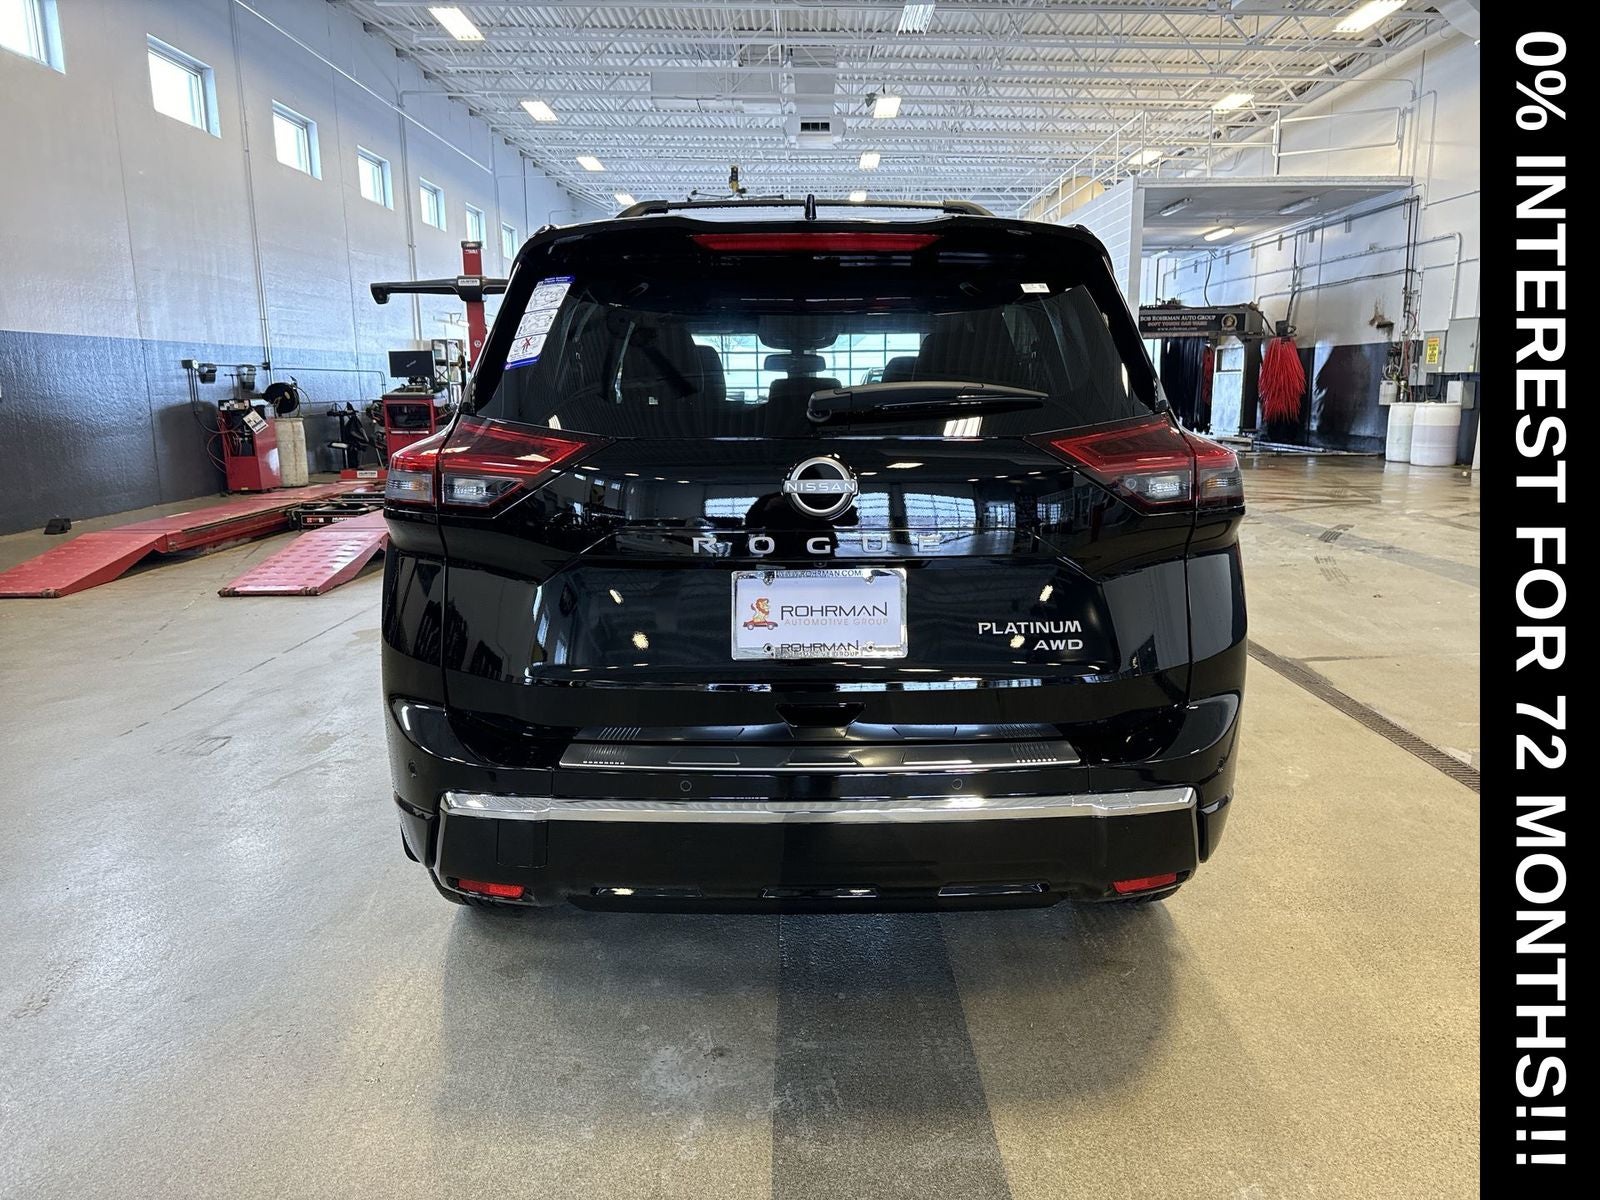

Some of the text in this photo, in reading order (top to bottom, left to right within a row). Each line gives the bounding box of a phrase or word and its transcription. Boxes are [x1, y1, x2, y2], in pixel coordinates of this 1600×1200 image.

[786, 482, 855, 492] NISSAN
[692, 537, 941, 555] ROGUE
[780, 602, 888, 620] ROHRMAN
[785, 618, 849, 626] AUTOMOTIVE
[978, 620, 1082, 634] PLATINUM
[780, 640, 859, 654] ROHRMAN
[1033, 639, 1084, 650] AWD
